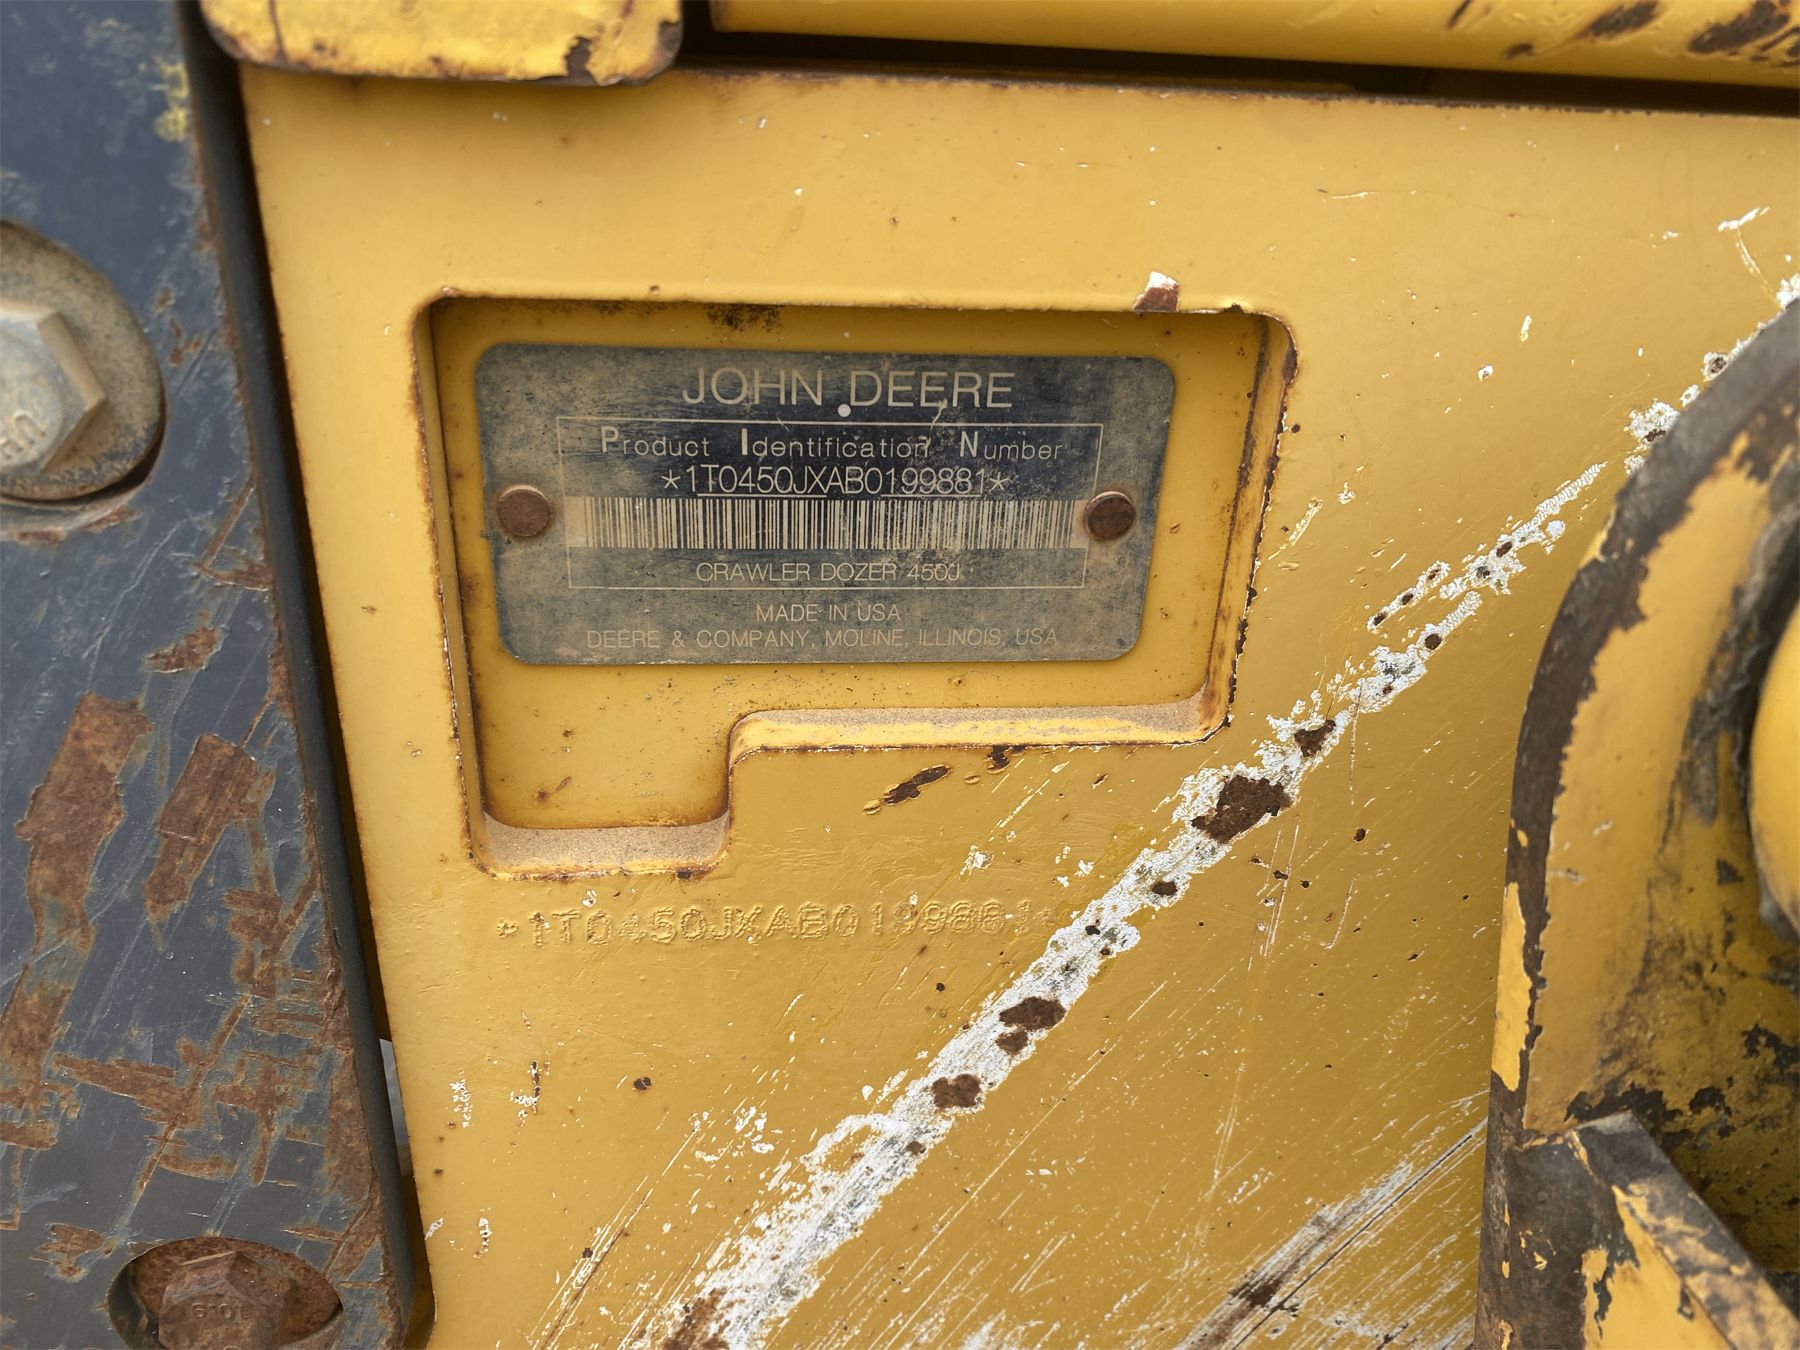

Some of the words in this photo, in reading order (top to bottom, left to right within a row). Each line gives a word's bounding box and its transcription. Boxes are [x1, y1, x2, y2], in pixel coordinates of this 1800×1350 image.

[682, 366, 823, 405] JOHN
[850, 370, 1016, 408] DEERE
[601, 425, 710, 458] Product
[741, 428, 929, 459] Identification
[959, 431, 1063, 460] Number
[696, 562, 811, 582] CRAWLER
[820, 562, 898, 582] DOZER
[907, 562, 961, 582] 450J
[756, 604, 819, 622] MADE
[829, 603, 848, 622] IN
[857, 603, 901, 622] USA
[587, 630, 661, 649] DEERE
[671, 630, 686, 648] &
[696, 629, 816, 650] COMPANY,
[825, 628, 909, 649] MOLINE,
[1016, 627, 1058, 646] USA
